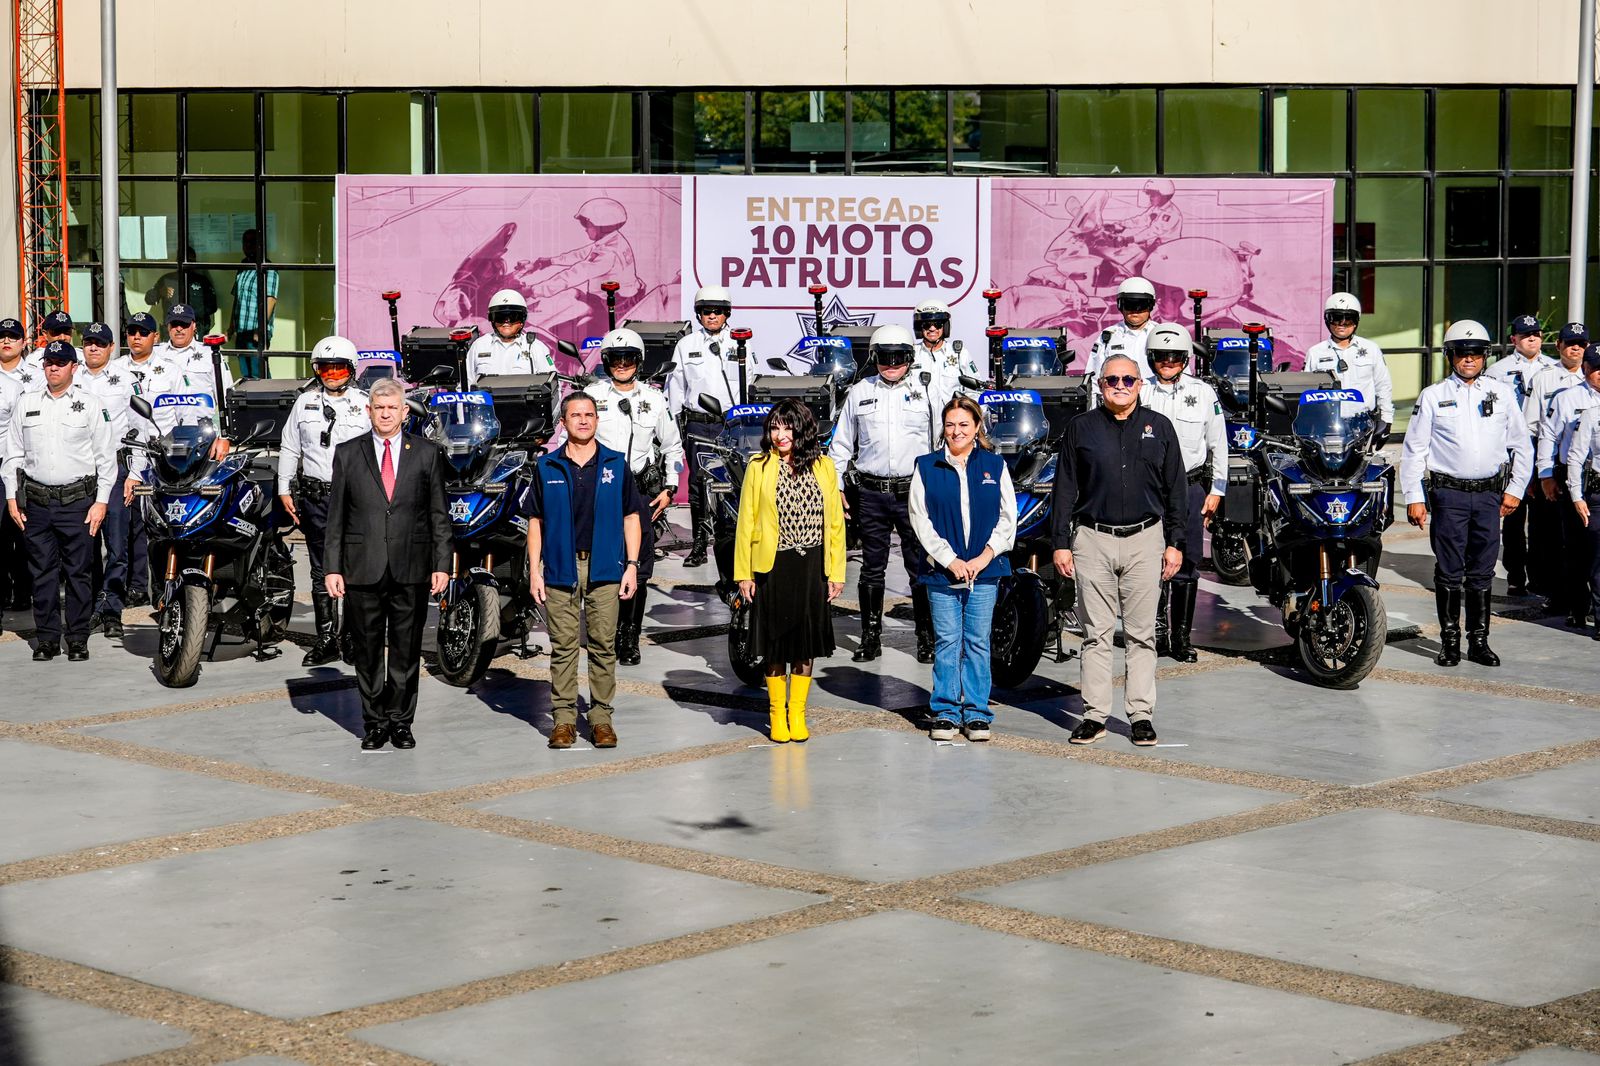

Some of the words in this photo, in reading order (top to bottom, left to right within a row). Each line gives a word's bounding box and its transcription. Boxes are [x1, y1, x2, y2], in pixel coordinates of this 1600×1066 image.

[746, 196, 906, 222] ENTREGA
[908, 205, 939, 222] DE
[750, 225, 796, 255] 10
[806, 224, 933, 256] MOTO
[721, 257, 964, 288] PATRULLAS
